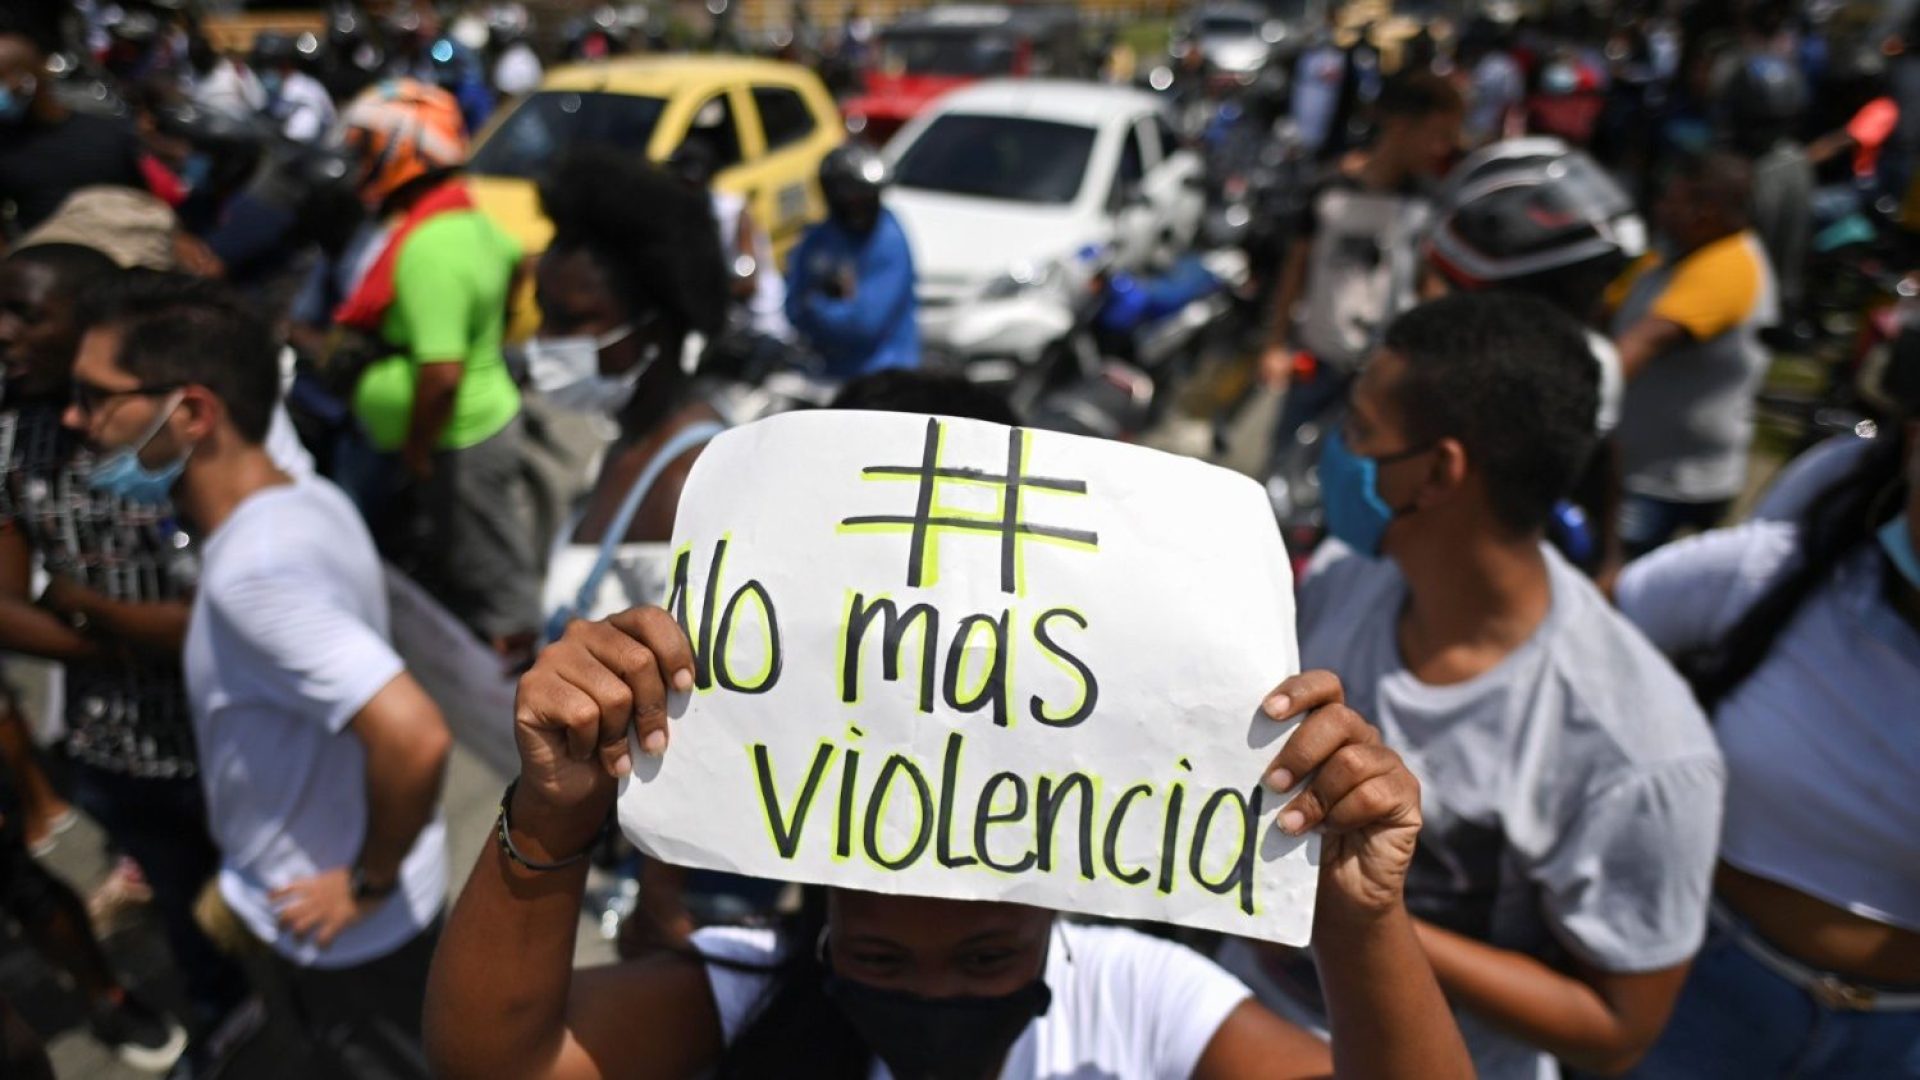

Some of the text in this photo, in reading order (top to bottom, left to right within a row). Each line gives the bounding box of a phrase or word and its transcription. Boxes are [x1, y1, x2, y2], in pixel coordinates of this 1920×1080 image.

[838, 417, 1099, 594] #
[667, 532, 1100, 728] No mas
[747, 726, 1263, 916] violencia
